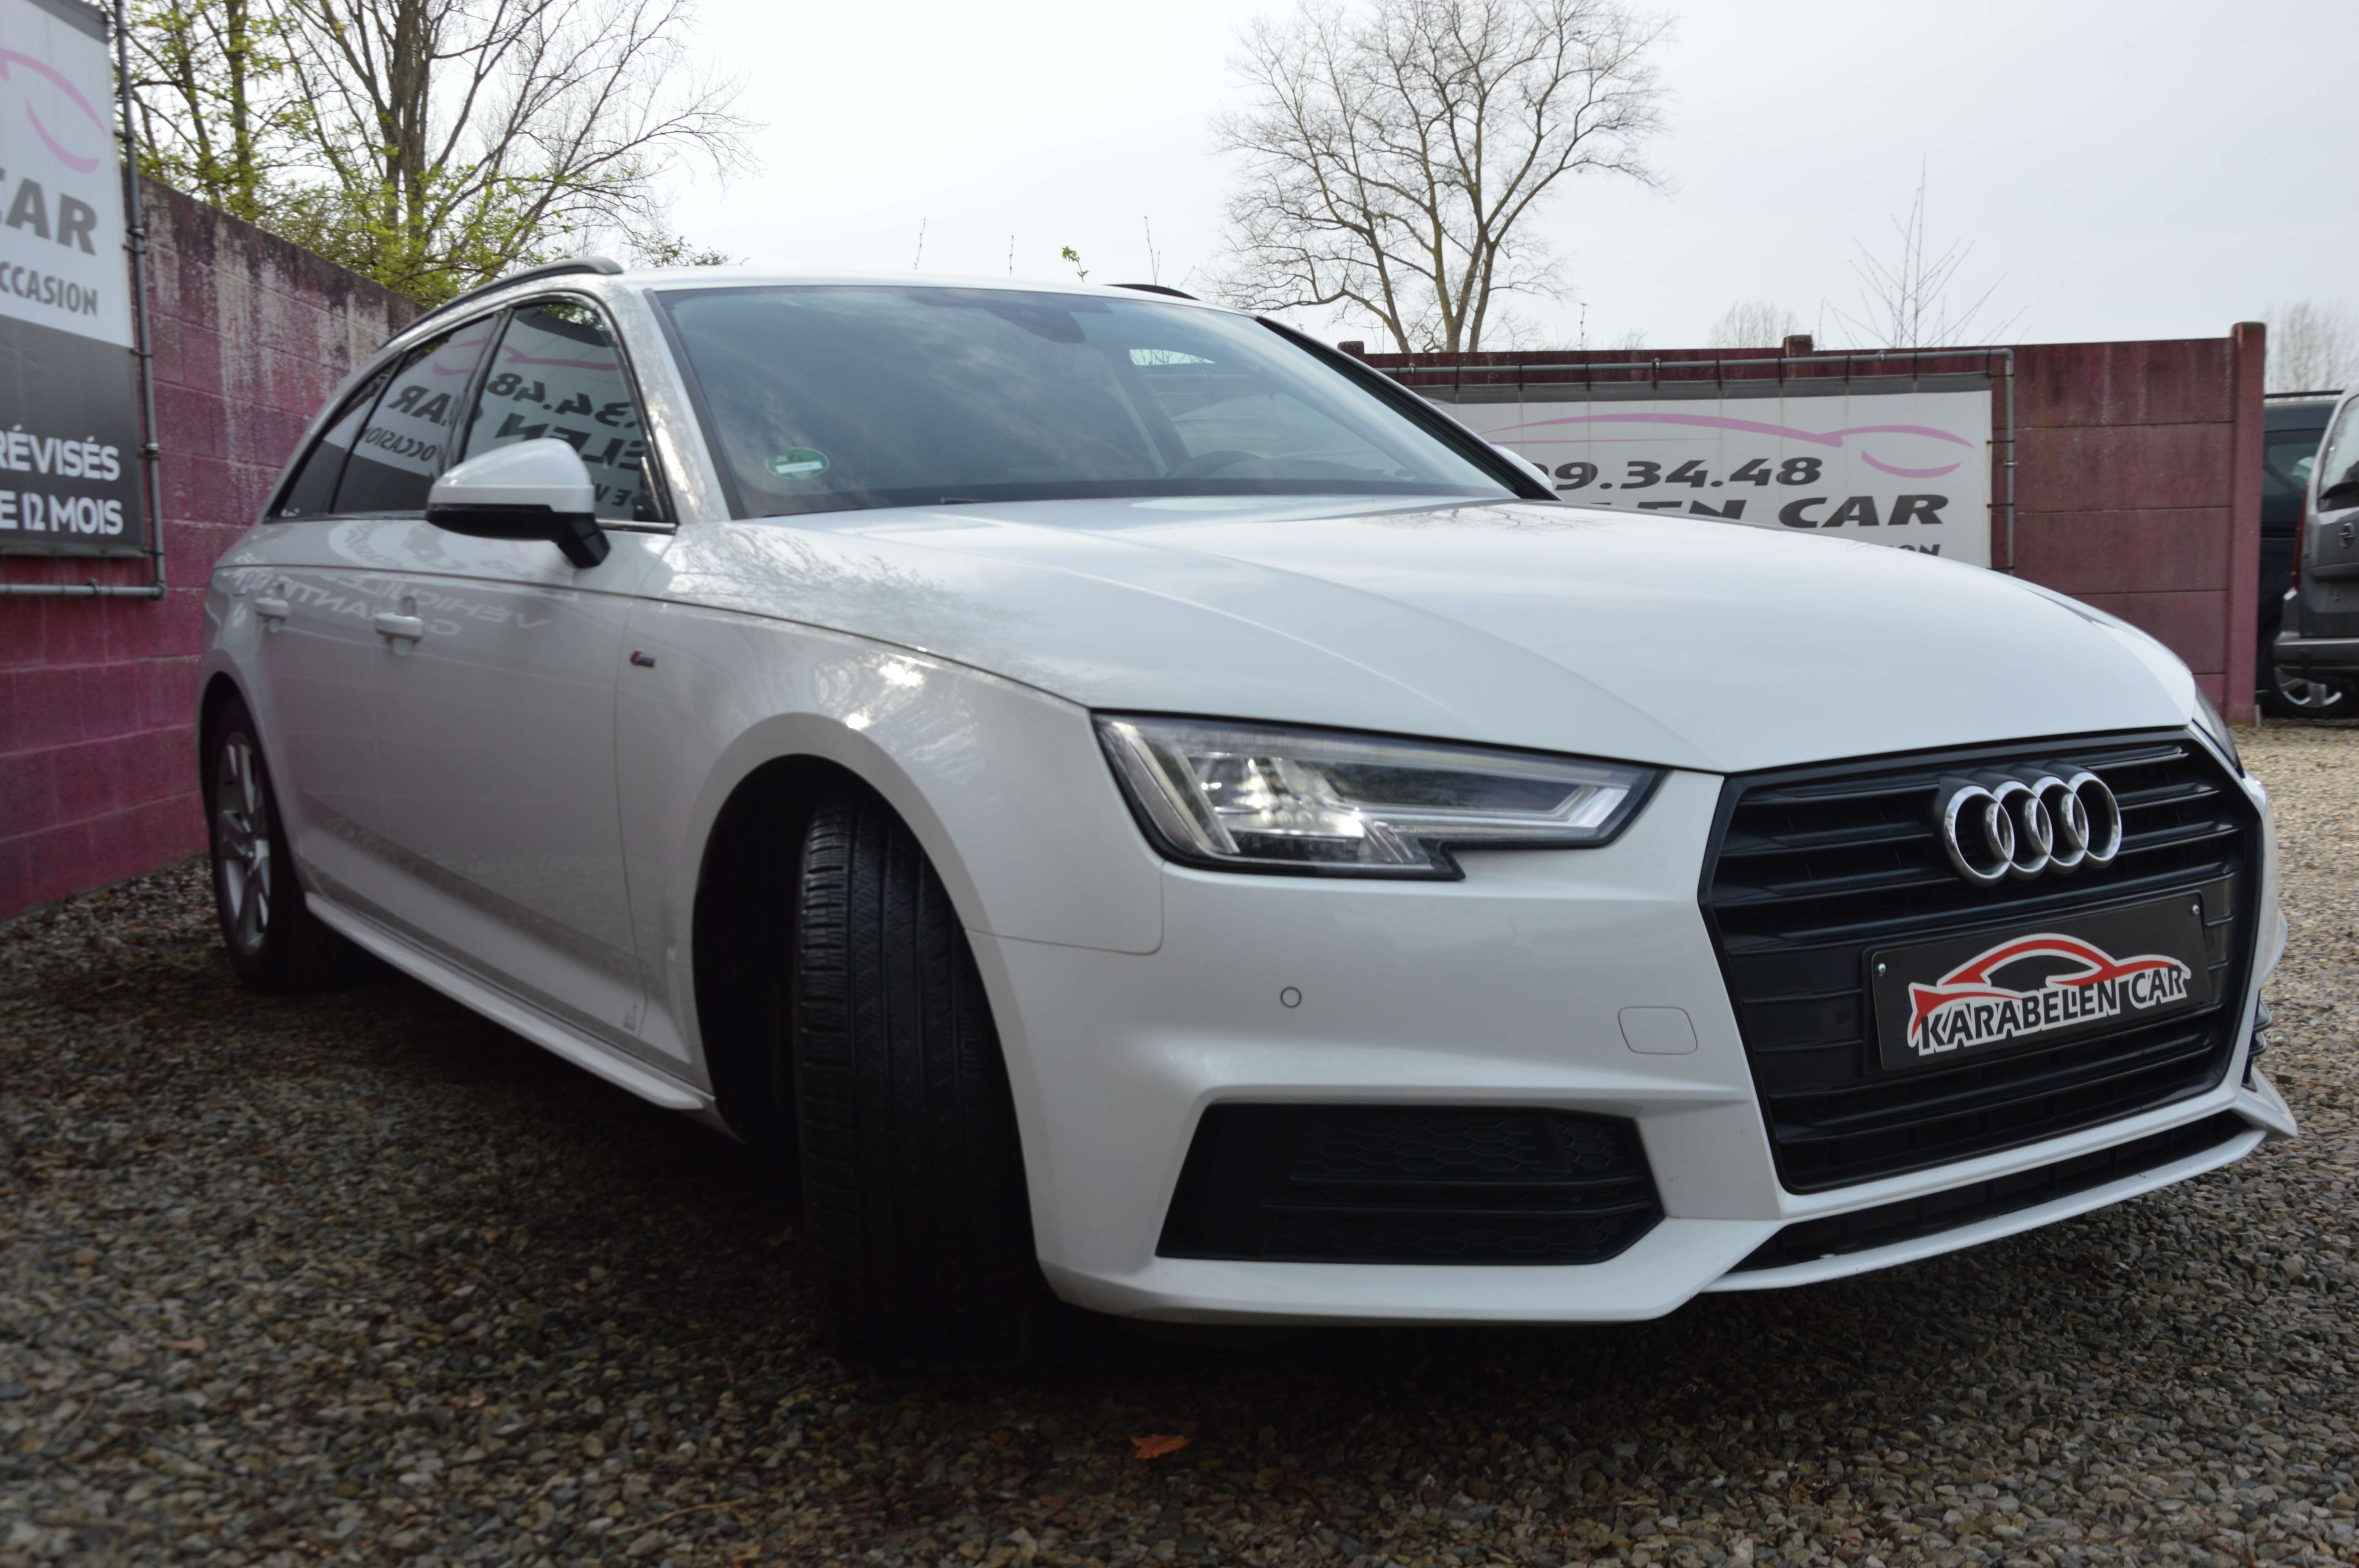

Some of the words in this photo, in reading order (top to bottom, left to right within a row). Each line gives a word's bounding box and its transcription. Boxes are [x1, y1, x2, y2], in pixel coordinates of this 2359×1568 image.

[0, 168, 97, 256] AR
[1531, 457, 1823, 491] 9.34.48
[48, 494, 124, 535] MOIS
[1779, 494, 1950, 528] CAR
[1920, 979, 2118, 1051] KARABELEN
[2130, 964, 2185, 1004] CAR
